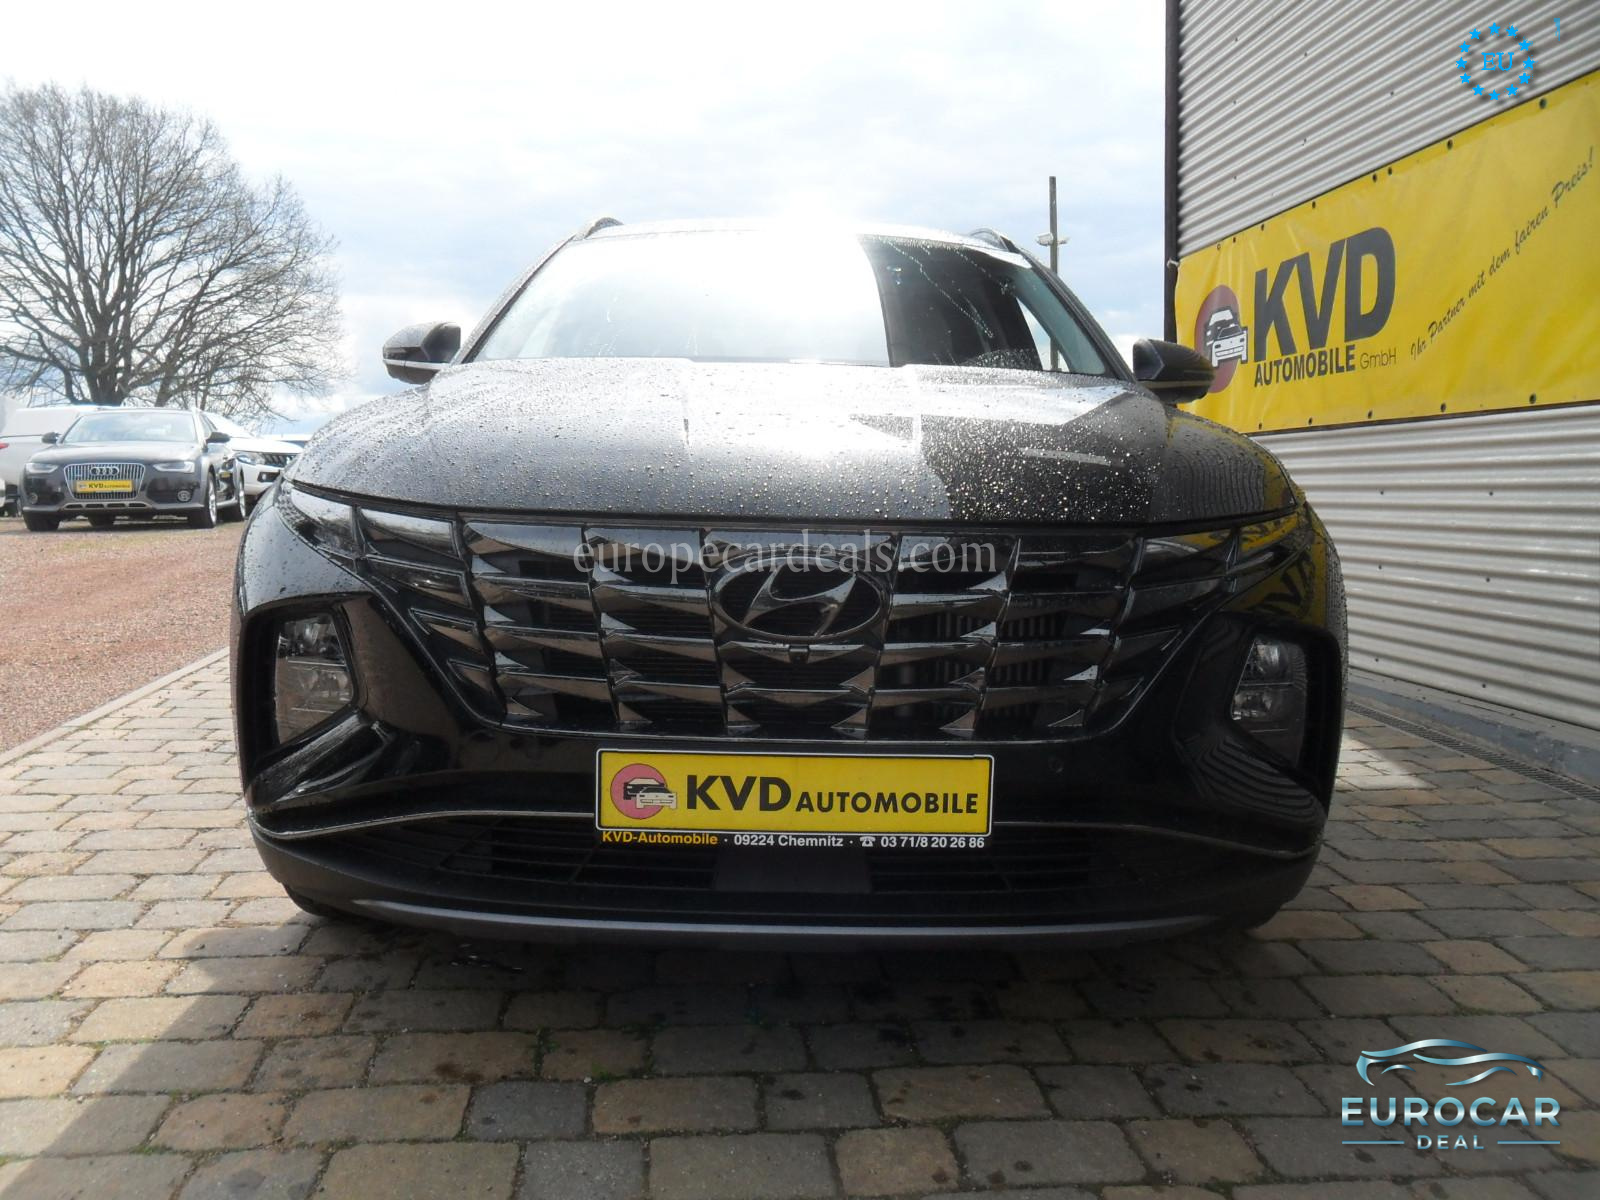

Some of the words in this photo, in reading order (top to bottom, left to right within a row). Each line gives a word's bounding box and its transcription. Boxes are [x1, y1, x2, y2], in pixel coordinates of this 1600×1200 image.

[1428, 297, 1465, 344] Partner
[1468, 270, 1485, 298] mit
[1489, 248, 1510, 276] dem
[1515, 205, 1549, 255] fairen
[1551, 145, 1593, 208] Preis!
[1254, 227, 1396, 362] KVD
[1254, 344, 1356, 387] AUTOMOBILE
[1360, 347, 1397, 369] GmbH
[686, 774, 792, 812] KVD
[795, 791, 979, 814] AUTOMOBILE
[602, 830, 718, 845] KVD-Automobile
[733, 834, 775, 846] 09224
[777, 835, 844, 847] Chemnitz
